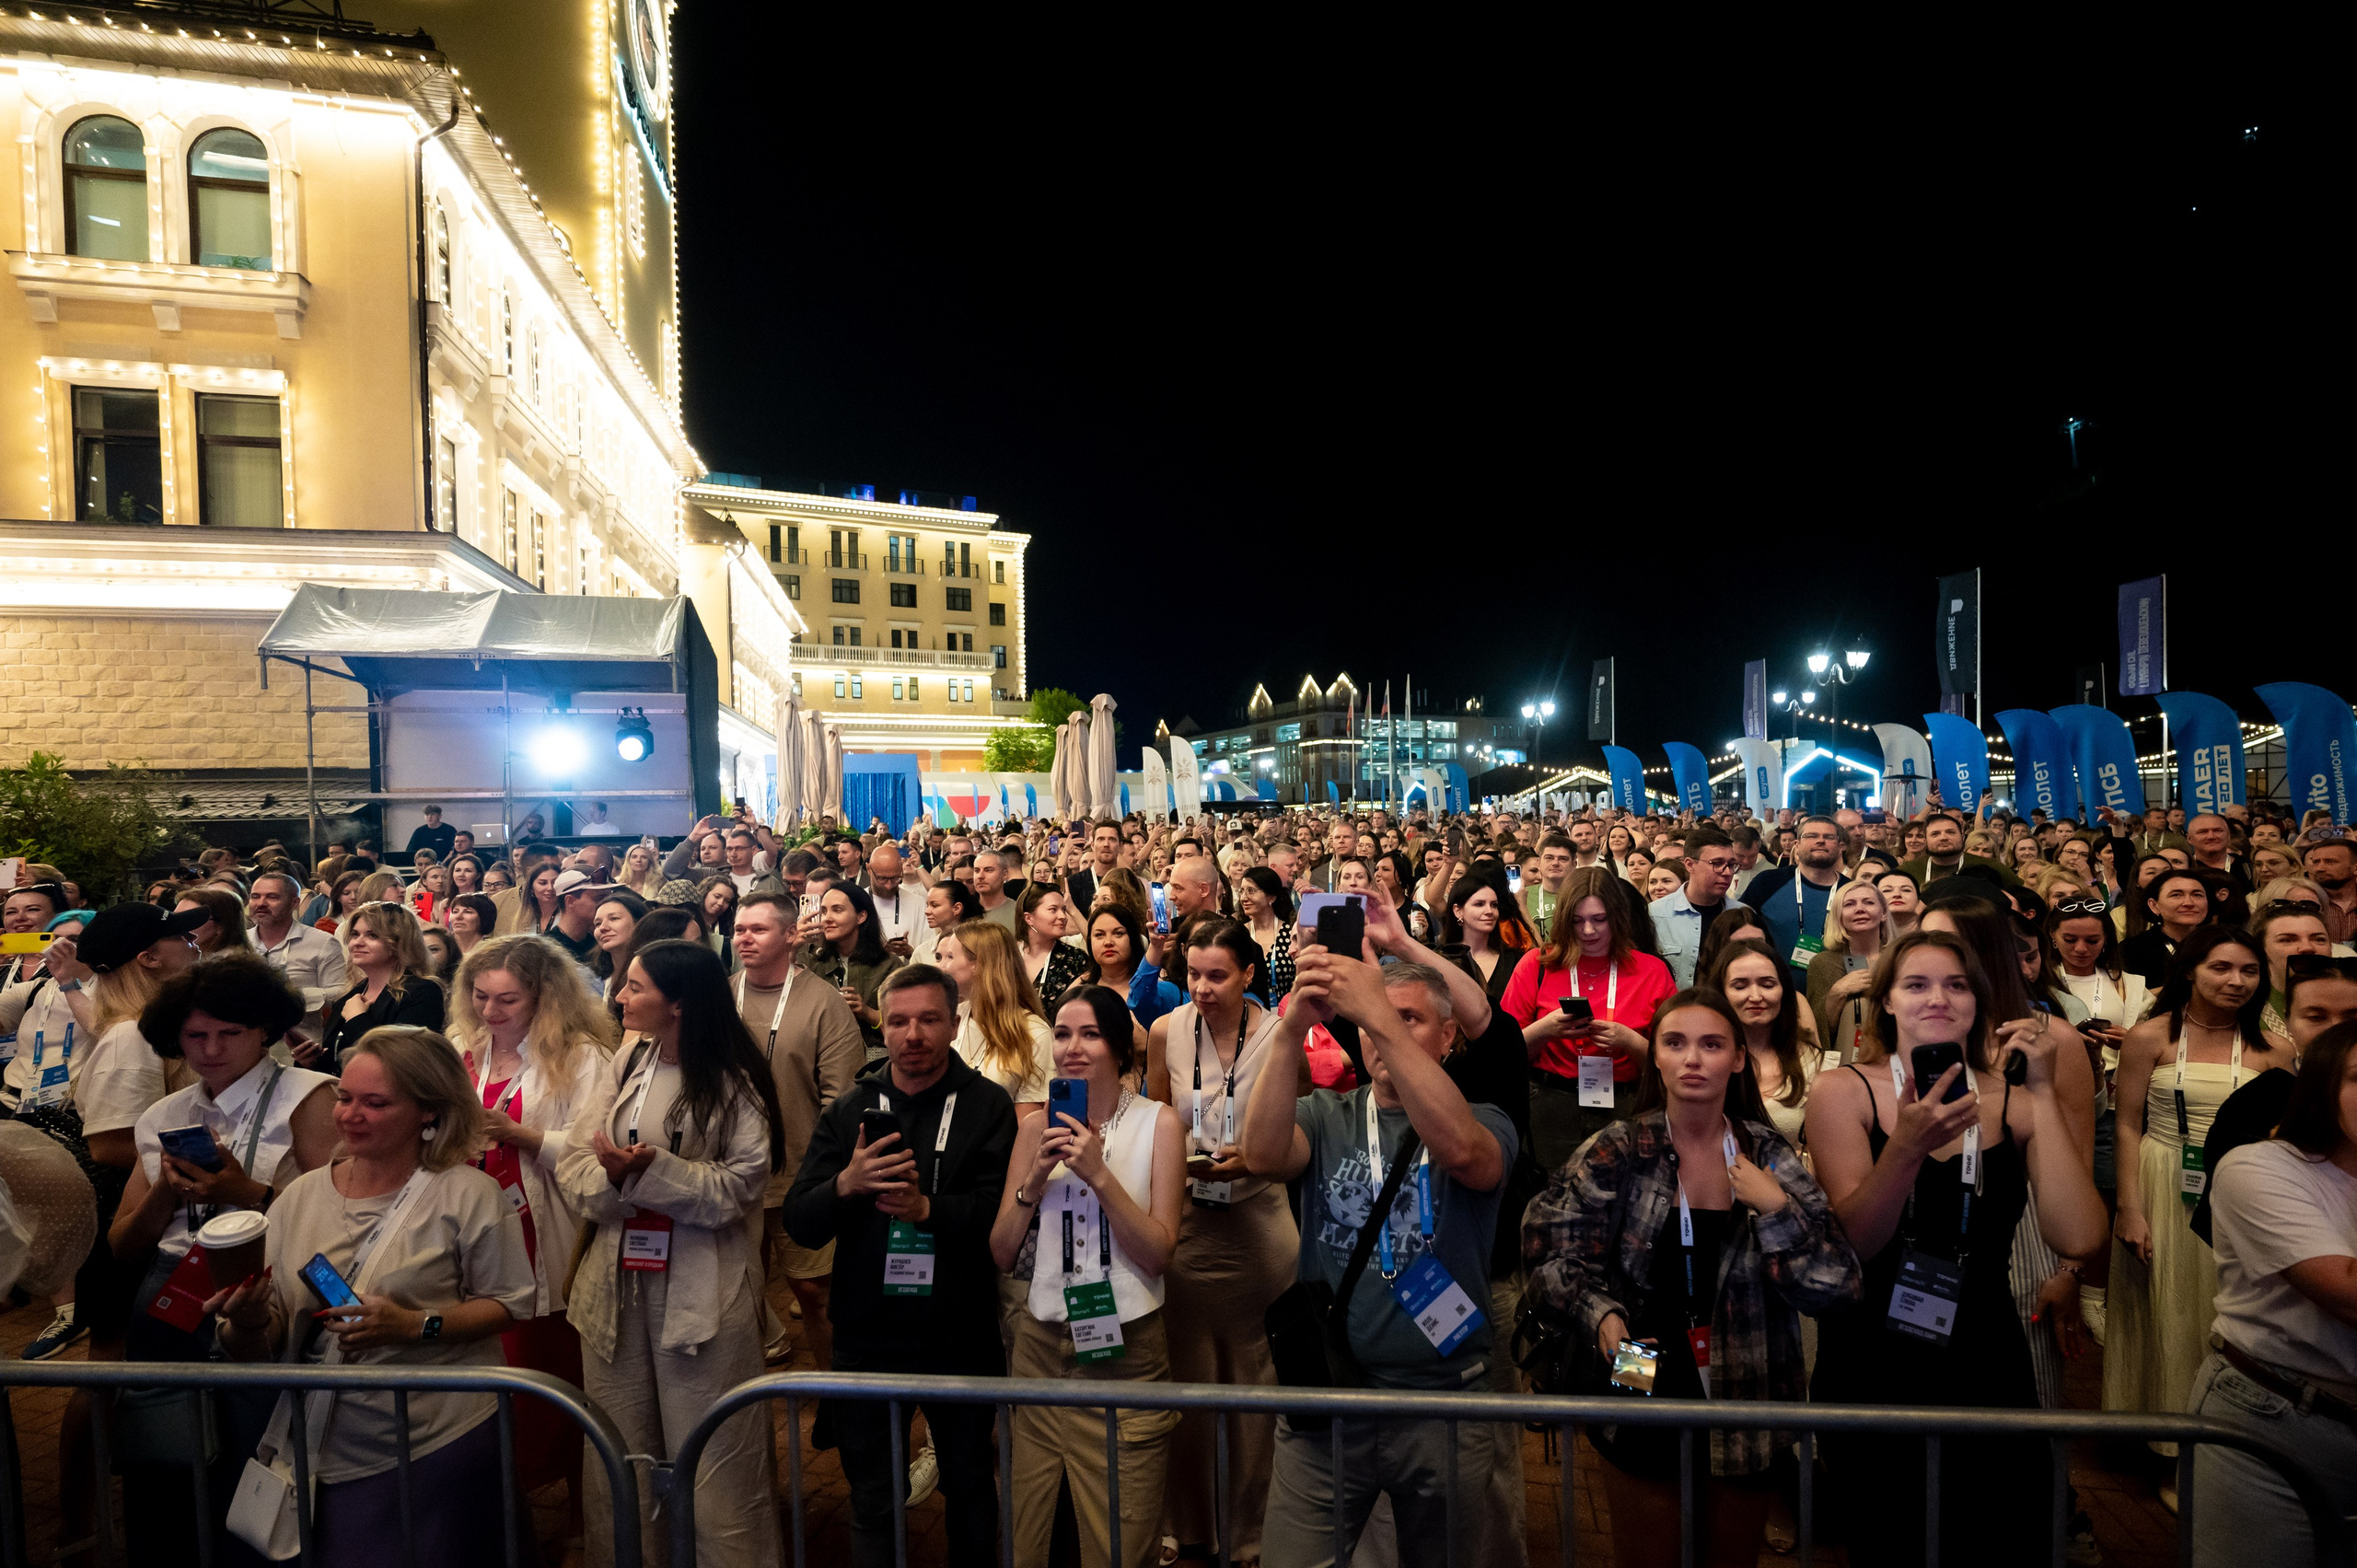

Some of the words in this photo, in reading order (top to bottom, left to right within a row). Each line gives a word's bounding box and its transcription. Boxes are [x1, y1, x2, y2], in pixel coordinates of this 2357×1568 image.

[2217, 749, 2229, 777] ЛЕТ
[1687, 781, 1704, 812] ВТБ
[2097, 762, 2125, 806] ПСБ
